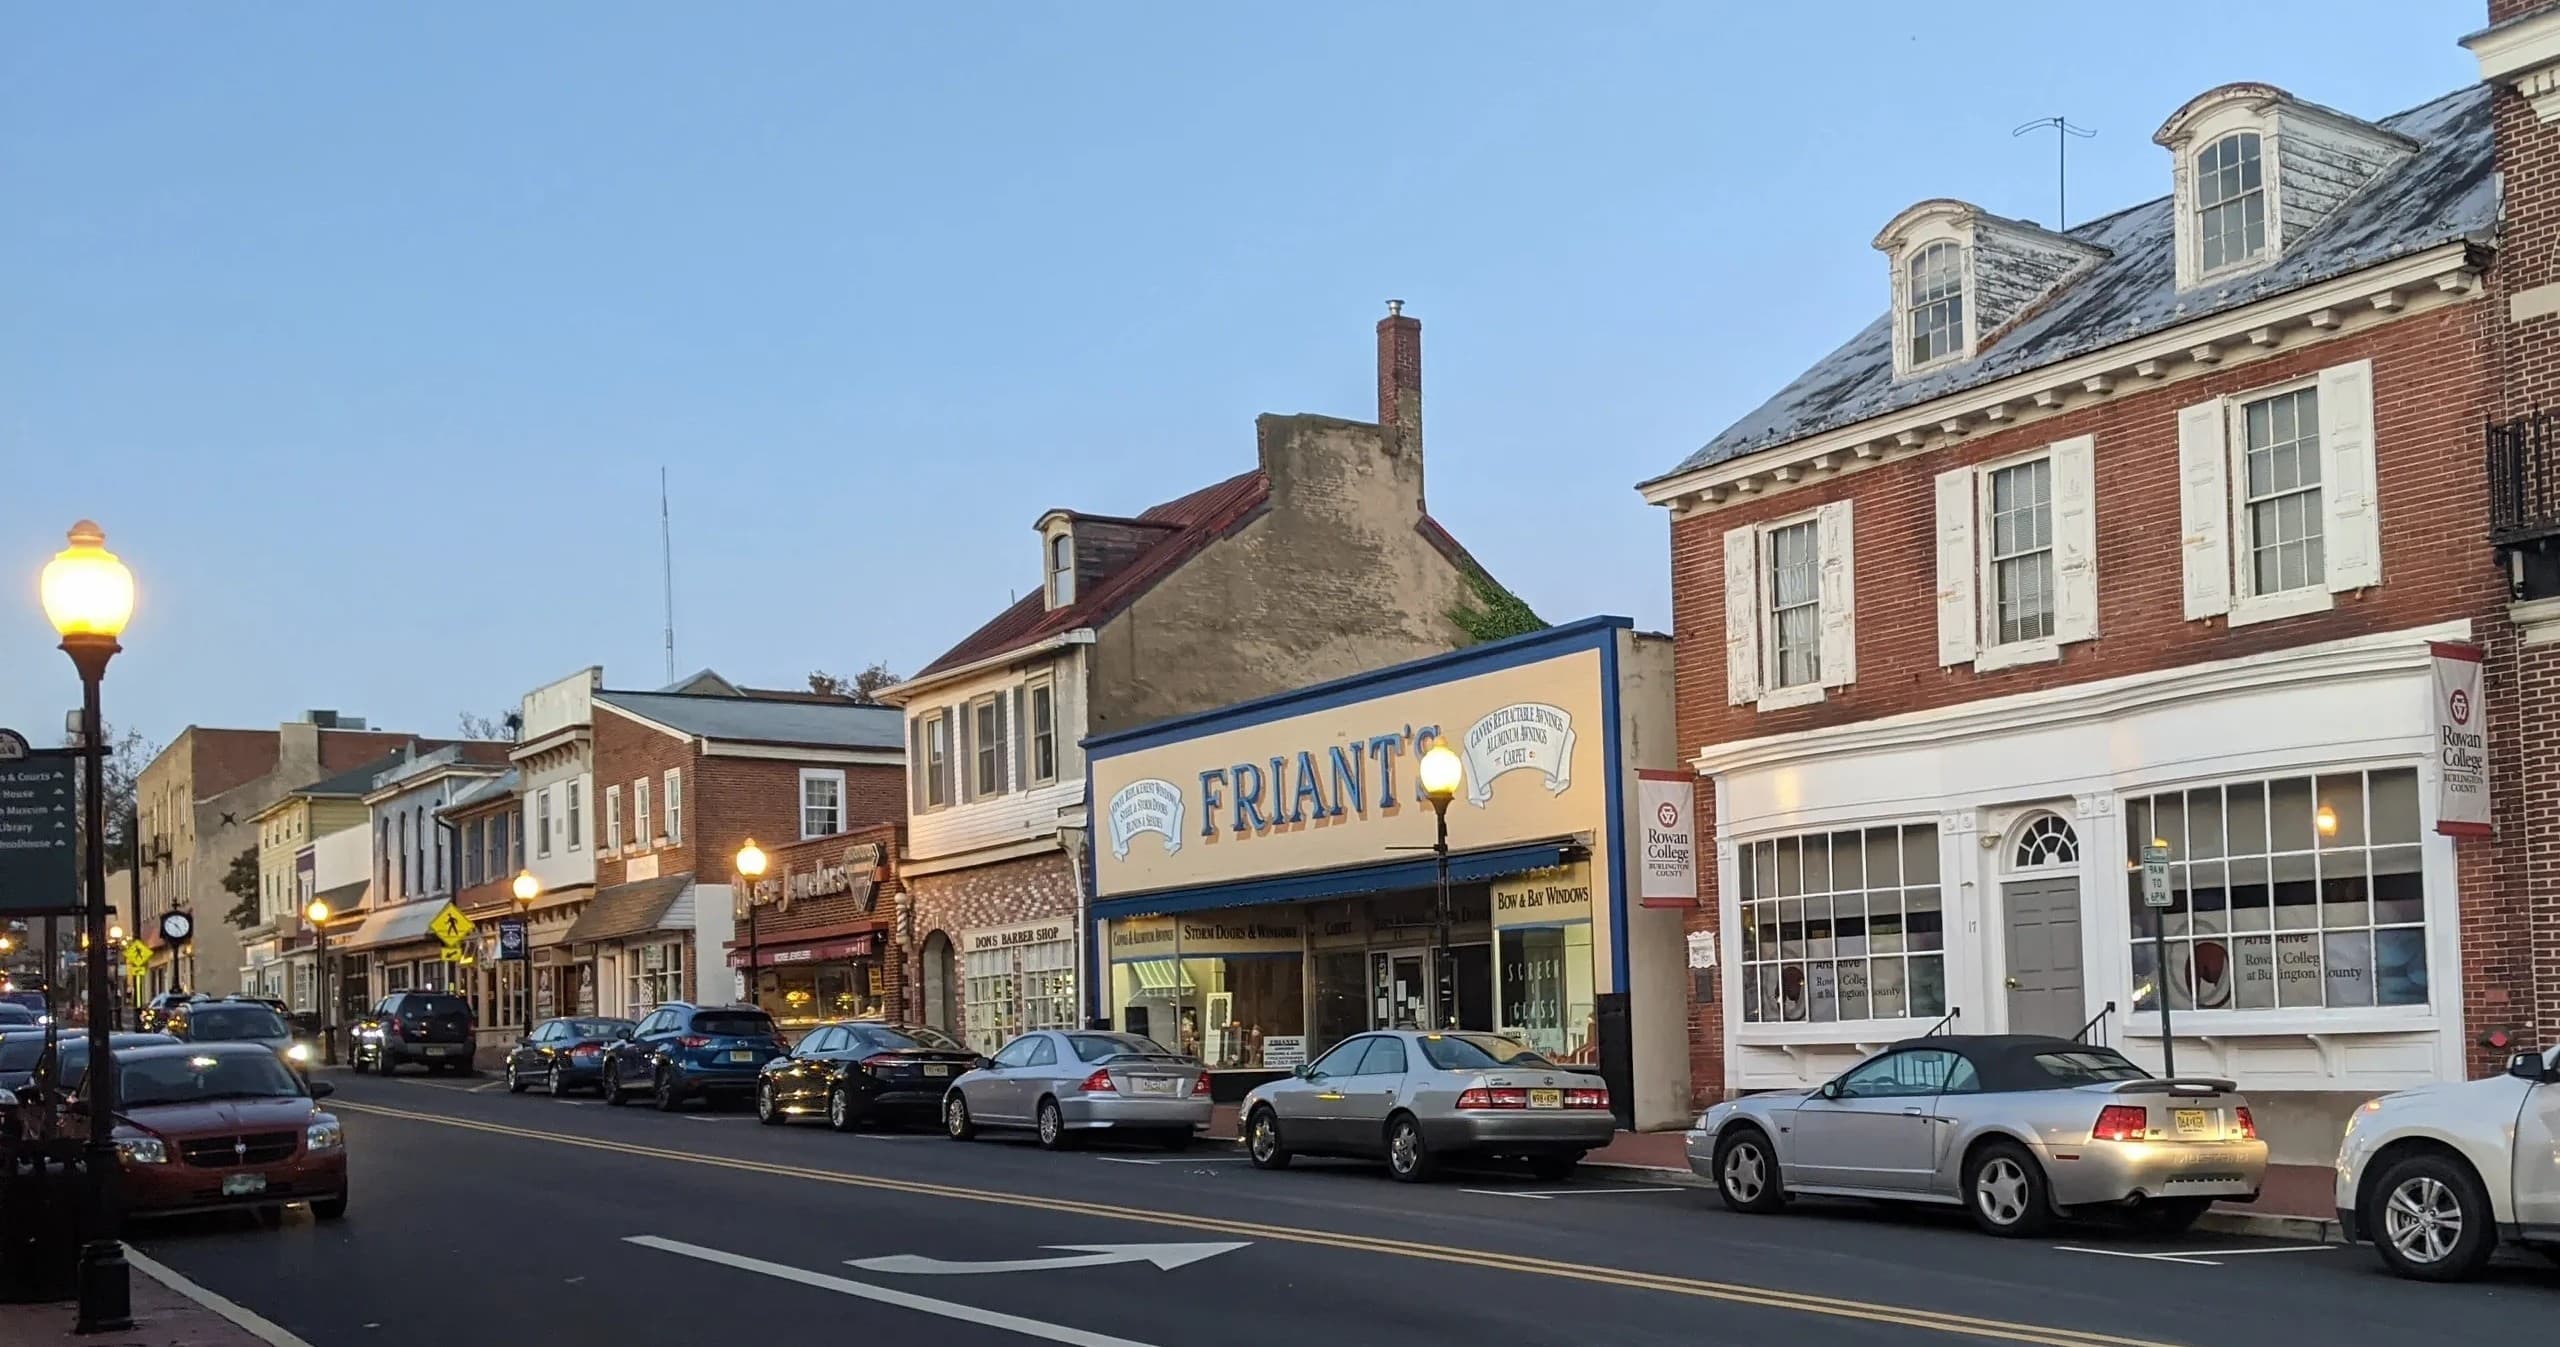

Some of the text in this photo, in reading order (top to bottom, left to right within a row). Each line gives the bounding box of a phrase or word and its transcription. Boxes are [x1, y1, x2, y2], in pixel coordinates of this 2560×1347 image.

[2442, 725, 2481, 748] Rowan
[1503, 748, 1526, 767] CARPET
[2443, 747, 2483, 775] College
[17, 772, 50, 781] Courts
[2444, 774, 2484, 785] BURLINGTON
[2, 790, 35, 798] House
[2450, 783, 2477, 793] COUNTY
[7, 806, 48, 814] Museum
[1648, 827, 1689, 845] Rowan
[1648, 844, 1689, 863] College
[1498, 886, 1589, 910] BOW & BAY WINDOWS
[1001, 930, 1034, 945] BARBER
[1036, 926, 1059, 941] SHOP
[1184, 924, 1214, 940] STORM
[1215, 924, 1245, 940] DOORS
[2246, 952, 2320, 967] Rowa Colleg
[1508, 959, 1560, 982] SCREEN
[2246, 968, 2361, 983] at Buington ounty
[1843, 974, 1867, 988] Colleg
[1514, 999, 1555, 1020] GLASS
